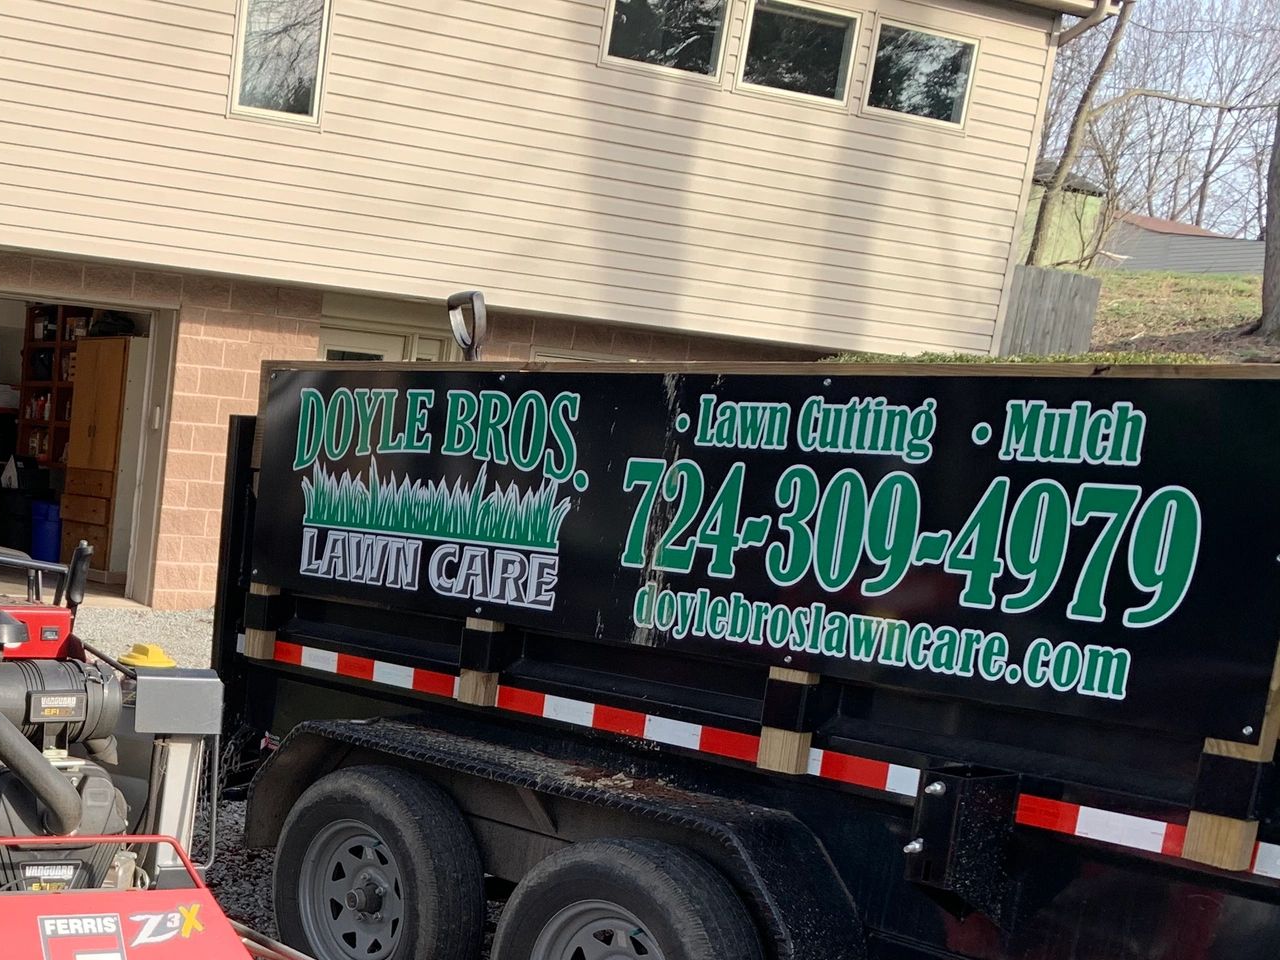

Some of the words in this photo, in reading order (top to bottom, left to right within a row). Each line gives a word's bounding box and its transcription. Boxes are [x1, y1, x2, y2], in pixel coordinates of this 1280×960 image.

[293, 387, 434, 471] DOYLE
[441, 389, 589, 492] BROS.
[694, 394, 791, 449] Lawn
[797, 396, 937, 464] Cutting
[999, 400, 1147, 467] Mulch
[300, 528, 422, 591] LAWN
[428, 544, 559, 611] CARE
[621, 457, 1202, 628] 724-309-4979
[633, 580, 1131, 700] doylebroslawncare.com
[25, 865, 74, 877] VANGUARD
[44, 917, 117, 935] FERRIS
